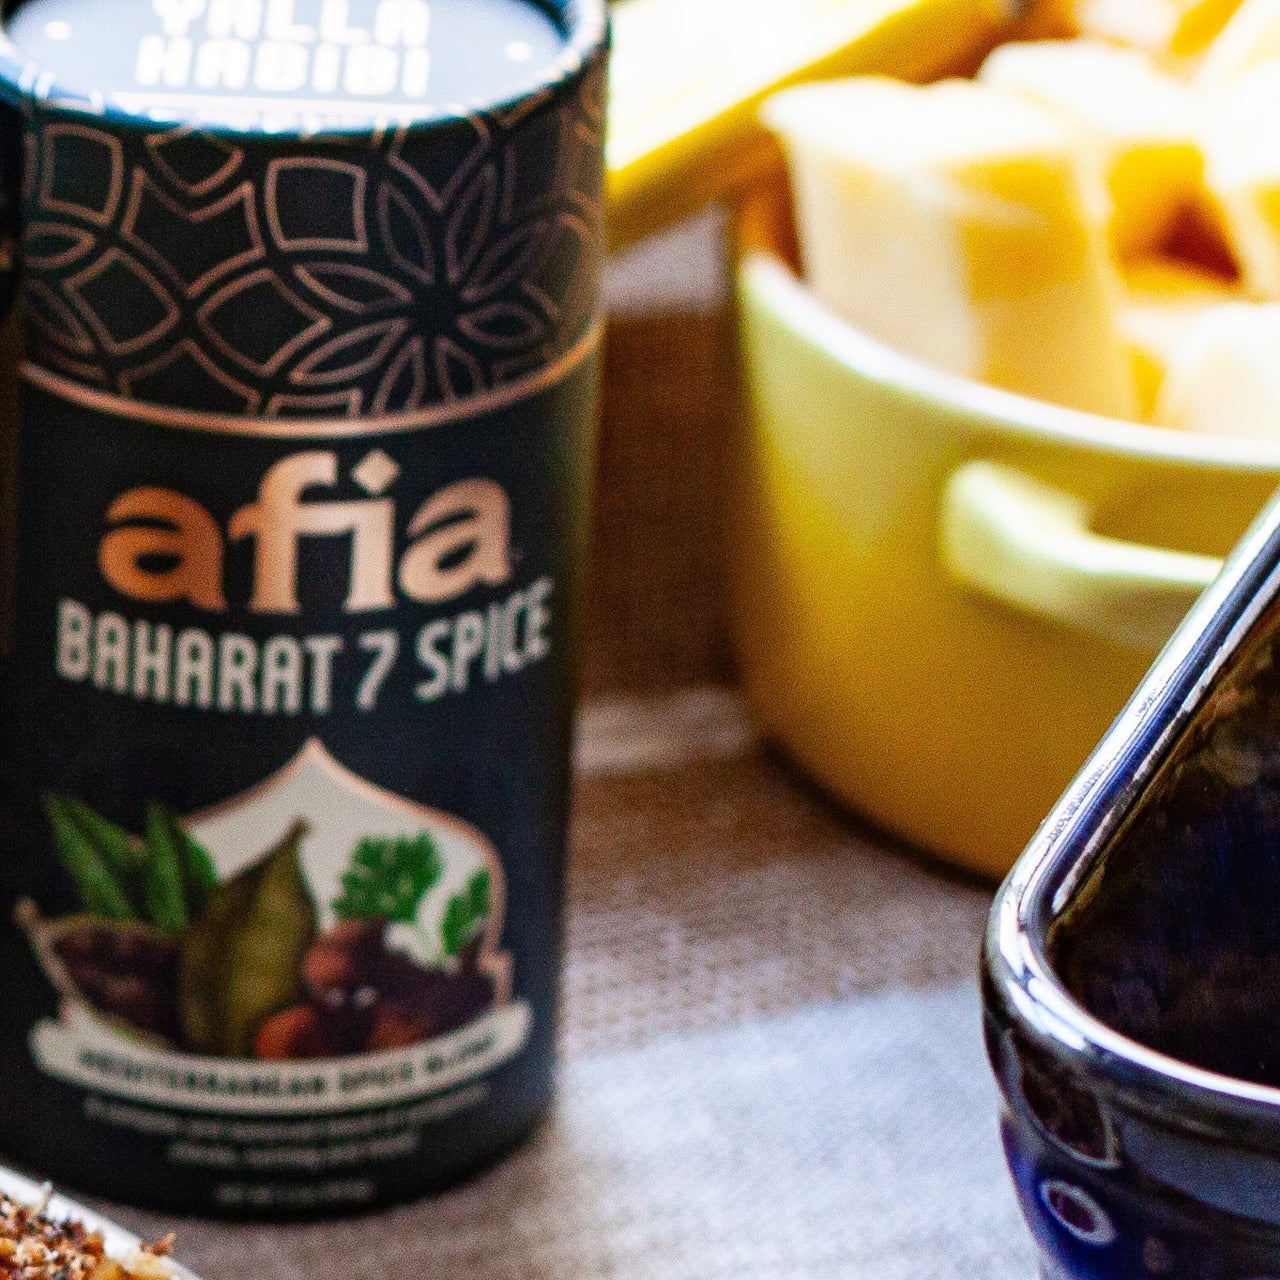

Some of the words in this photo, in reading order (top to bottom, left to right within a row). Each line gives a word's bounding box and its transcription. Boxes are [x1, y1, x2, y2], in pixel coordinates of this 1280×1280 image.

[134, 34, 431, 98] HABIBI
[98, 450, 513, 615] afia
[55, 597, 343, 715] BAHARAT
[357, 630, 402, 712] 7
[414, 574, 555, 702] SPICE
